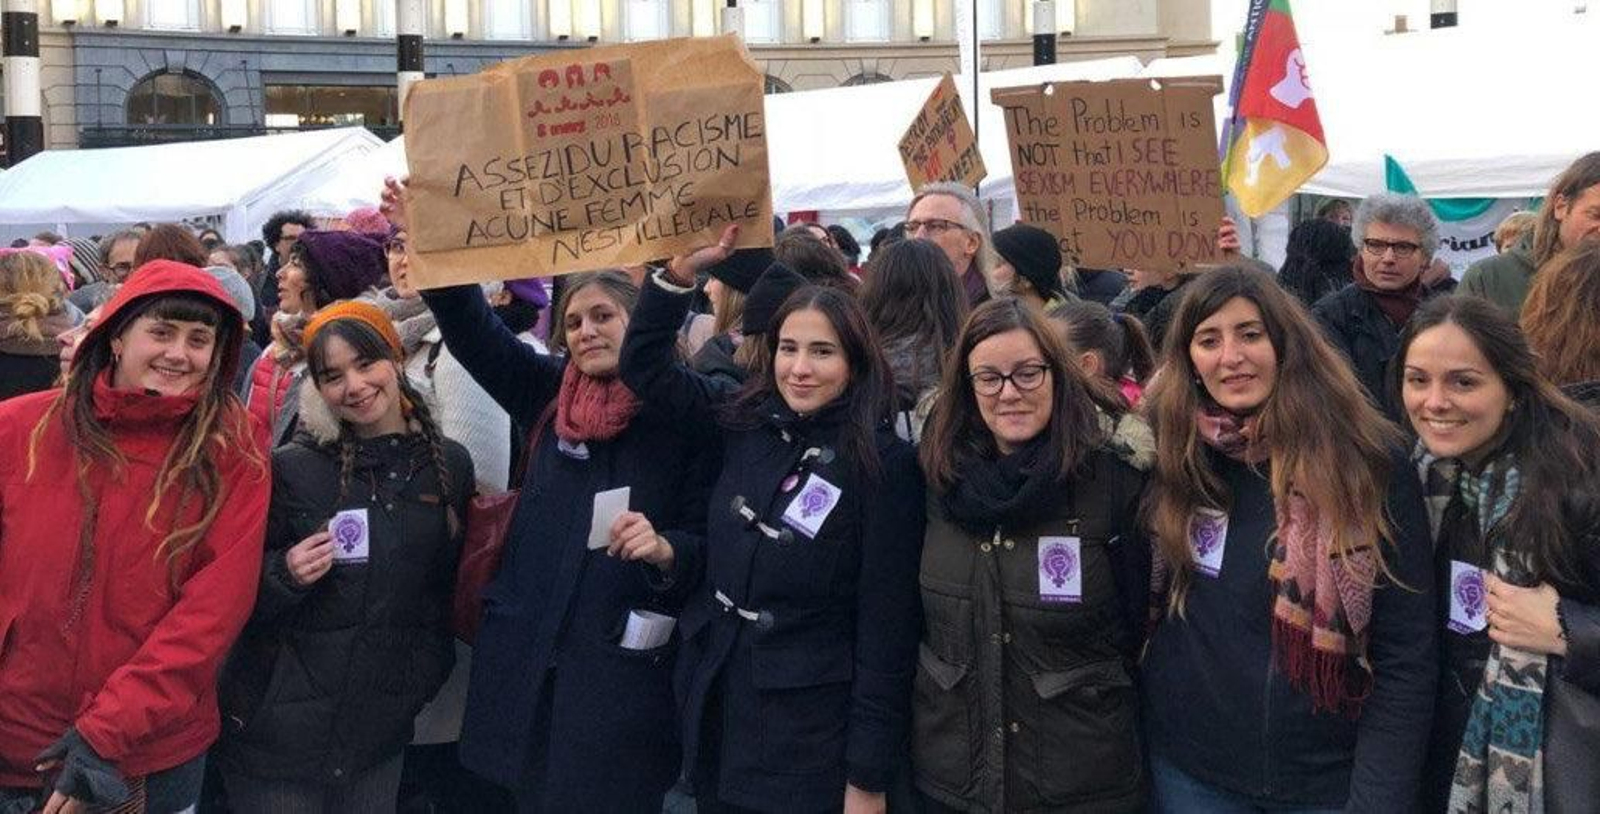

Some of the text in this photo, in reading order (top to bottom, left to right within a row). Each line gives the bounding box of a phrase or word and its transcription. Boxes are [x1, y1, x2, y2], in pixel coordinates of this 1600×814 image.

[1004, 104, 1060, 137] The
[1071, 97, 1160, 134] Problem
[565, 139, 611, 175] DU
[622, 112, 762, 163] RACISME
[1017, 142, 1060, 166] NOT
[1116, 140, 1123, 165] I
[1131, 138, 1179, 167] SEE
[500, 143, 739, 210] ET D'EXCLUSION
[1018, 168, 1219, 199] SEXISM EVERYWHERE
[465, 181, 695, 245] ACUNE FEMME
[1024, 202, 1061, 222] the
[1071, 198, 1161, 225] Problem
[1060, 227, 1083, 253] at
[1106, 228, 1157, 260] YOU
